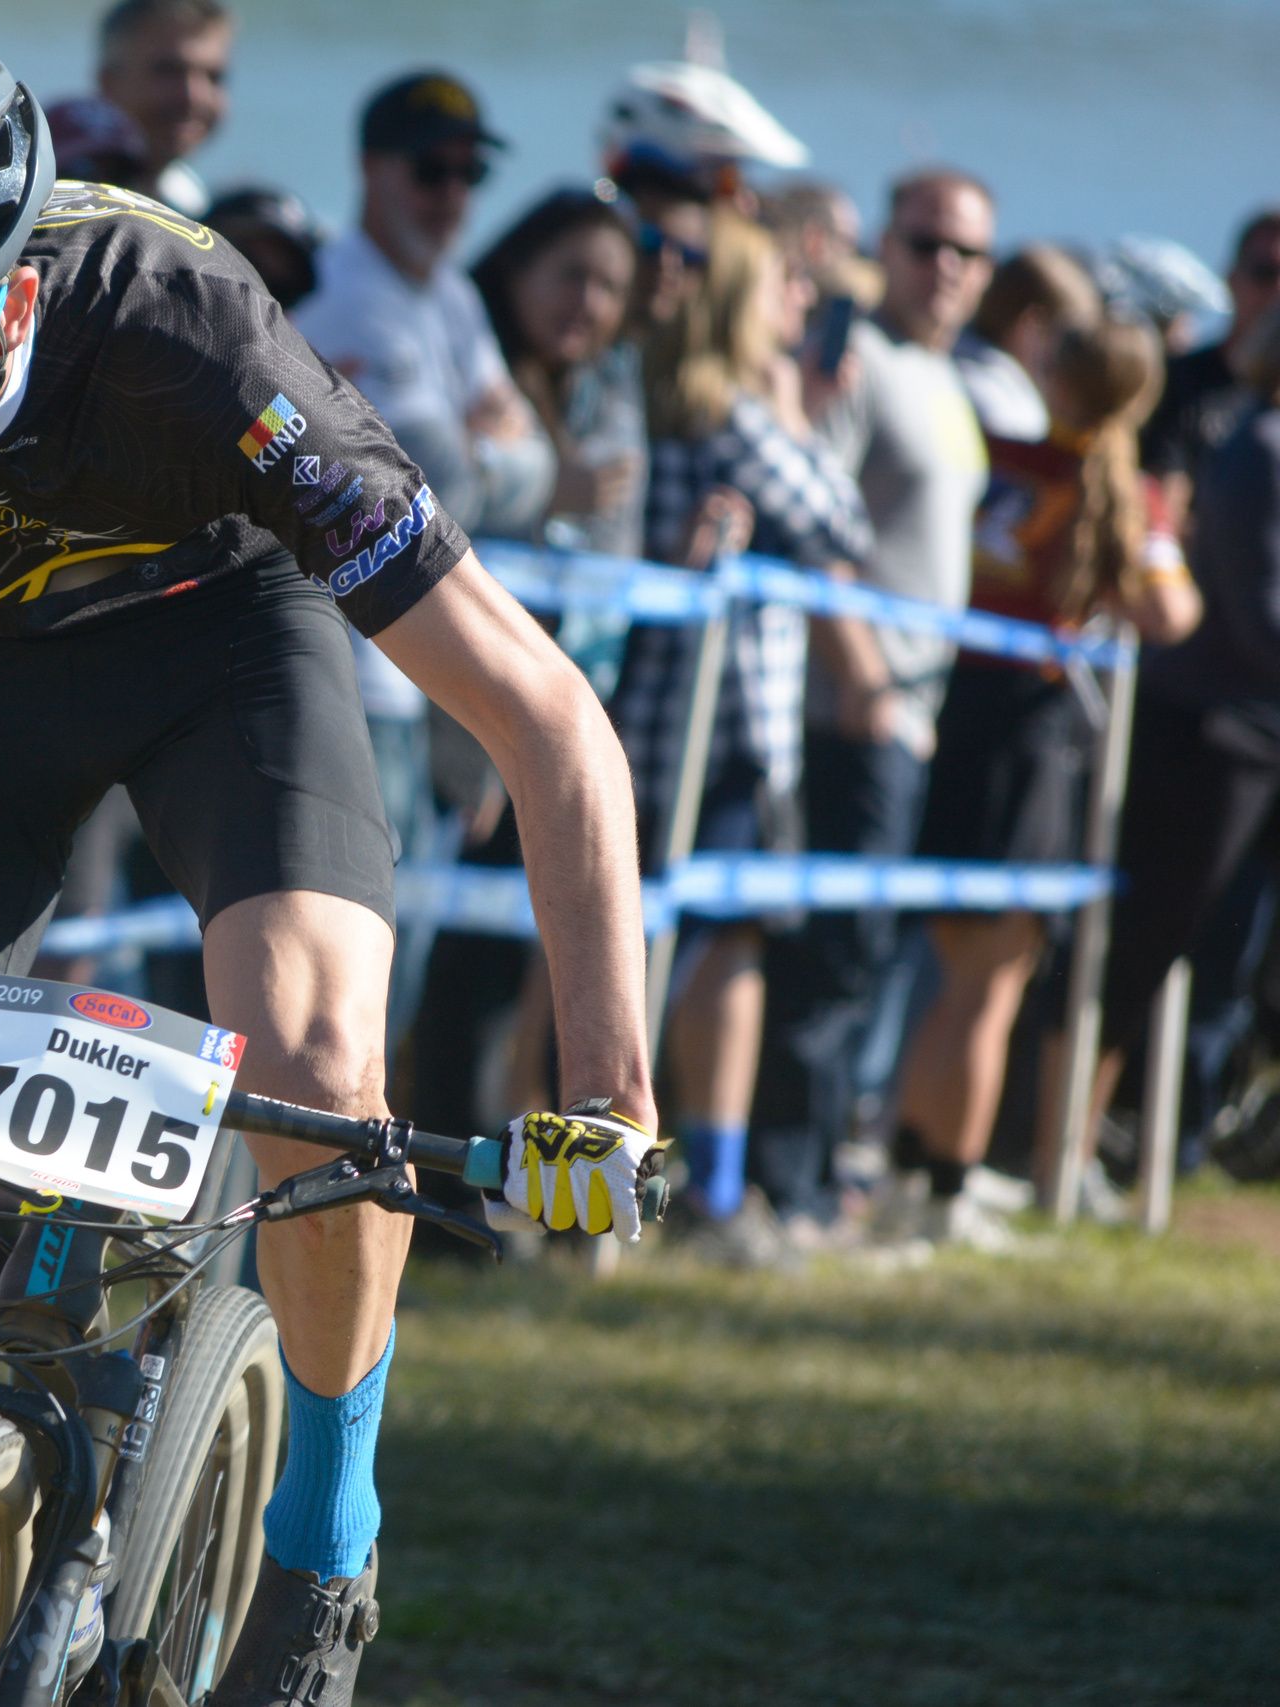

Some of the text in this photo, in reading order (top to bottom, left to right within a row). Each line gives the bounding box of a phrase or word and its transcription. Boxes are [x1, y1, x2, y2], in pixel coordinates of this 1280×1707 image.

[251, 413, 307, 473] KIND
[329, 483, 436, 596] GIANT
[83, 997, 138, 1023] SoCal
[46, 1028, 150, 1080] Dukler
[200, 1029, 220, 1060] NICA
[33, 1172, 80, 1189] KENDA
